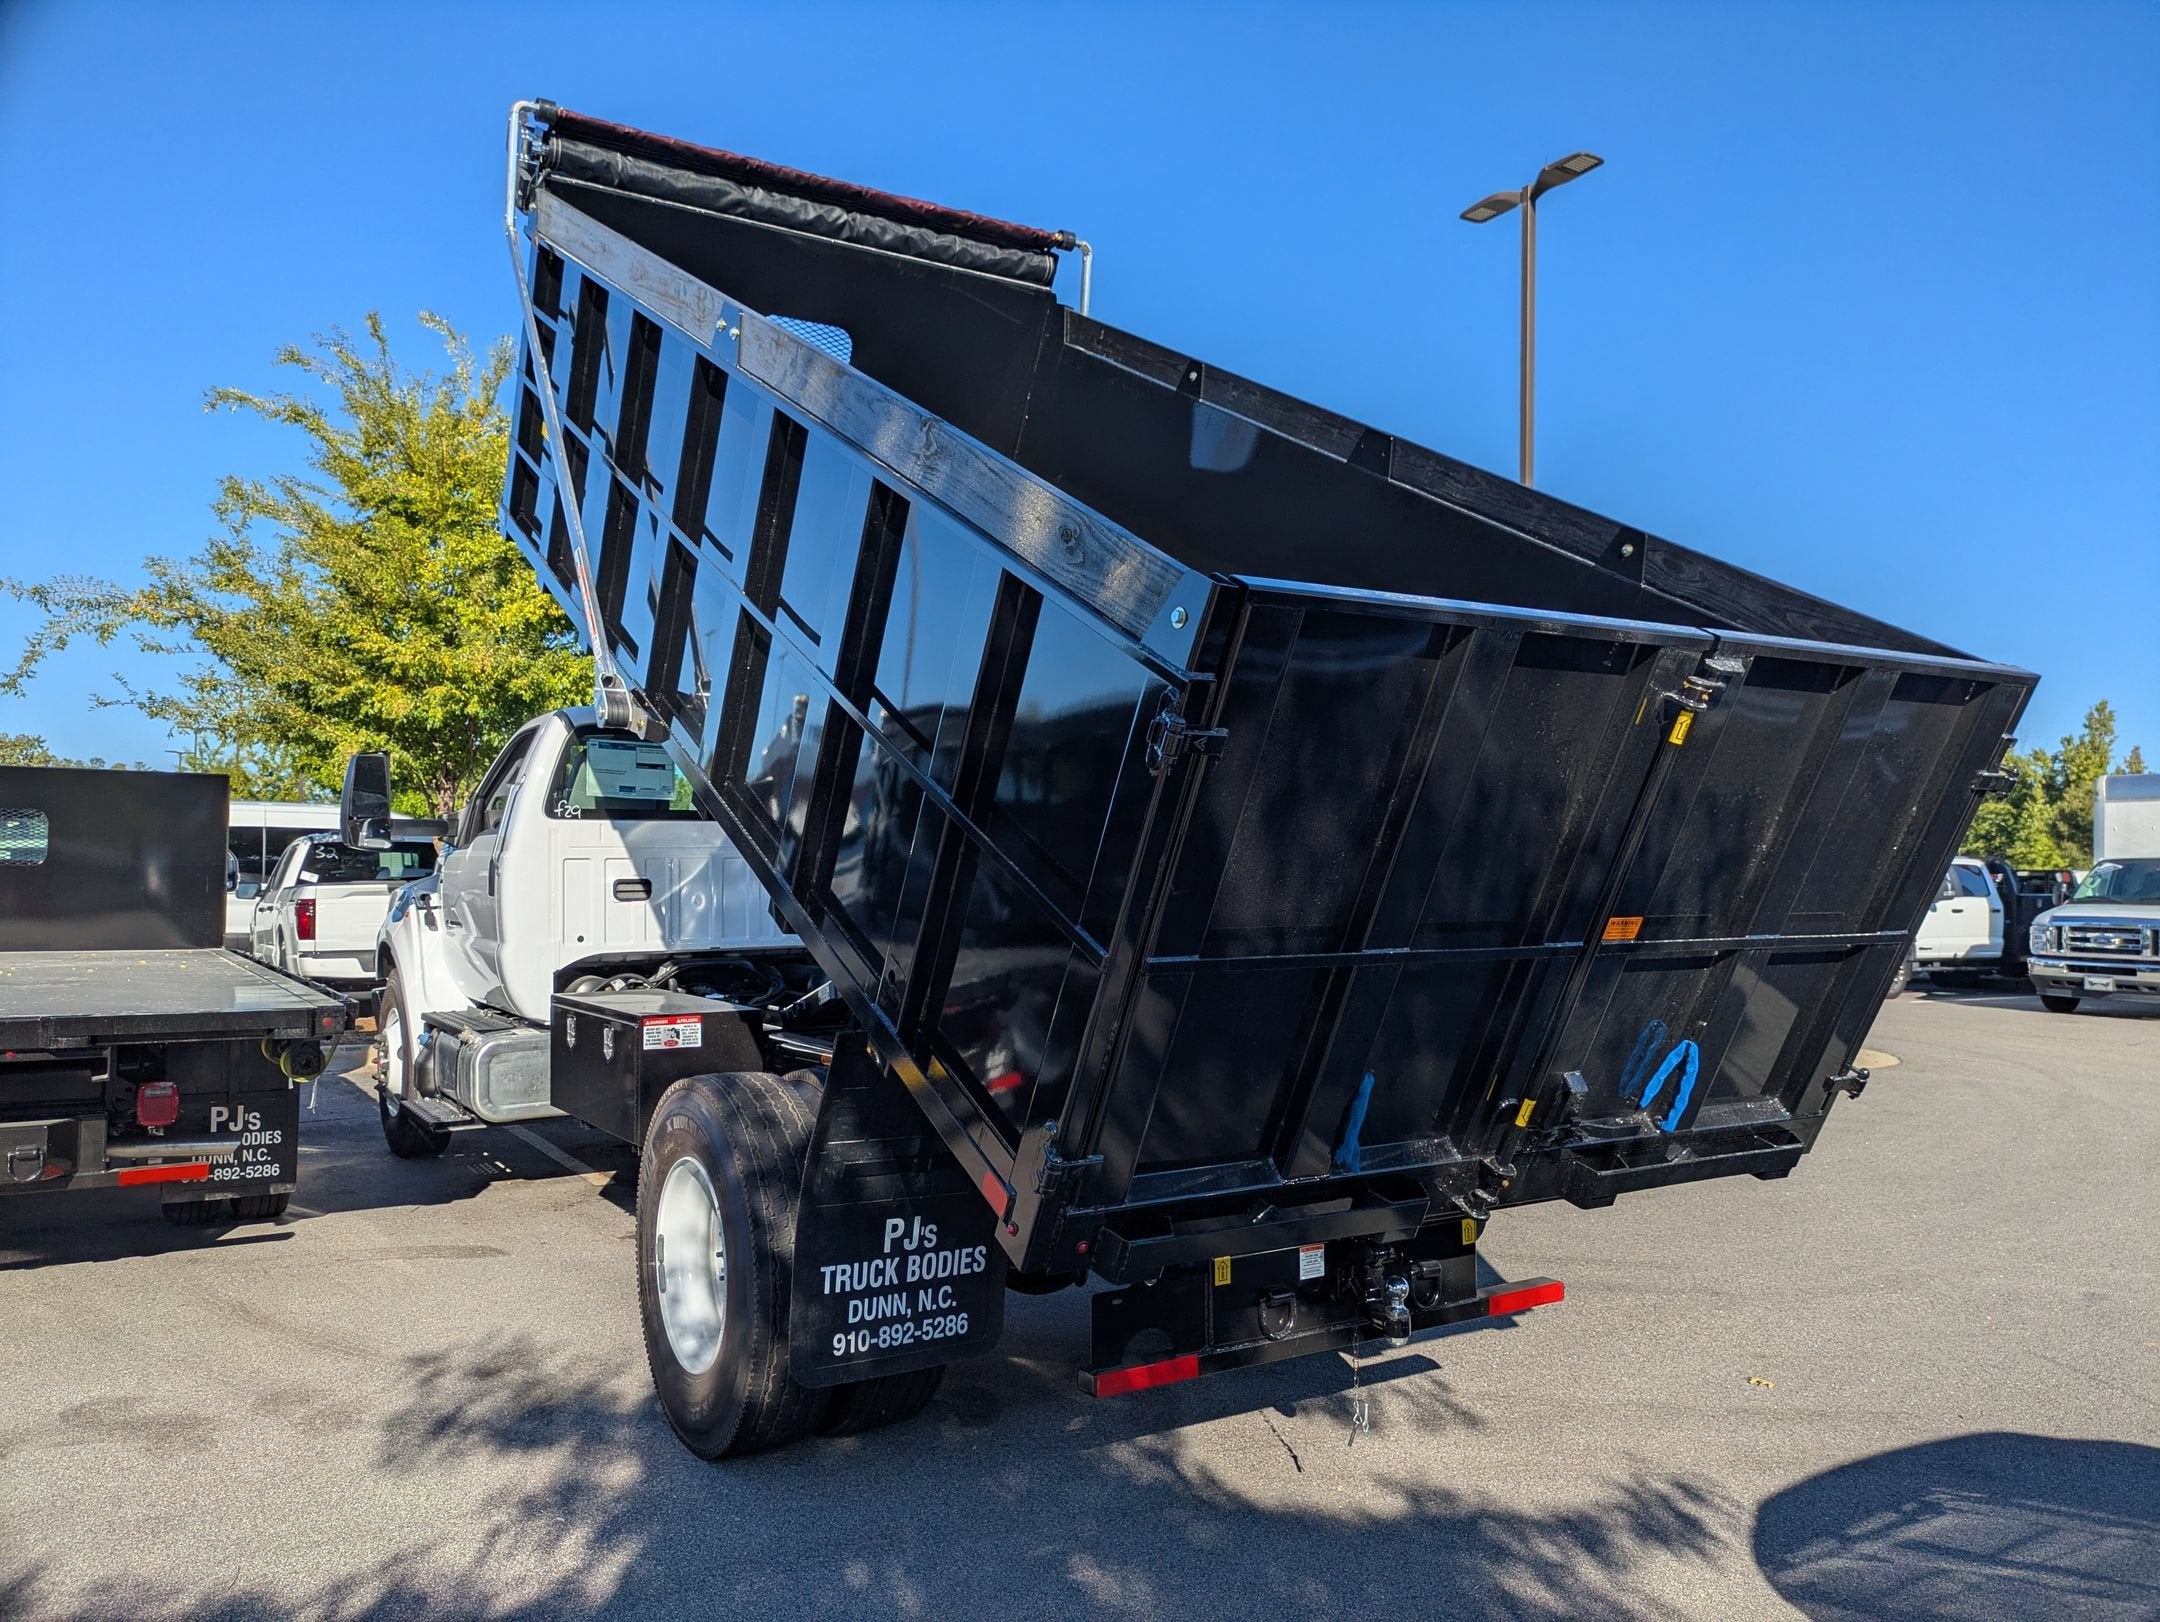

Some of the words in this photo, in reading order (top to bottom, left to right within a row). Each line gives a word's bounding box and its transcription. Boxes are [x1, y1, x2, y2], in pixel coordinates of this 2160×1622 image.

[315, 845, 339, 860] 32
[241, 1130, 282, 1146] ODIES
[242, 1148, 272, 1162] N.C.
[181, 1163, 280, 1183] -892-5286
[820, 1256, 900, 1295] TRUCK
[906, 1245, 987, 1283] BODIES
[848, 1291, 912, 1324] DUNN,
[918, 1285, 957, 1312] N.C.
[832, 1312, 969, 1357] 910-892-5286
